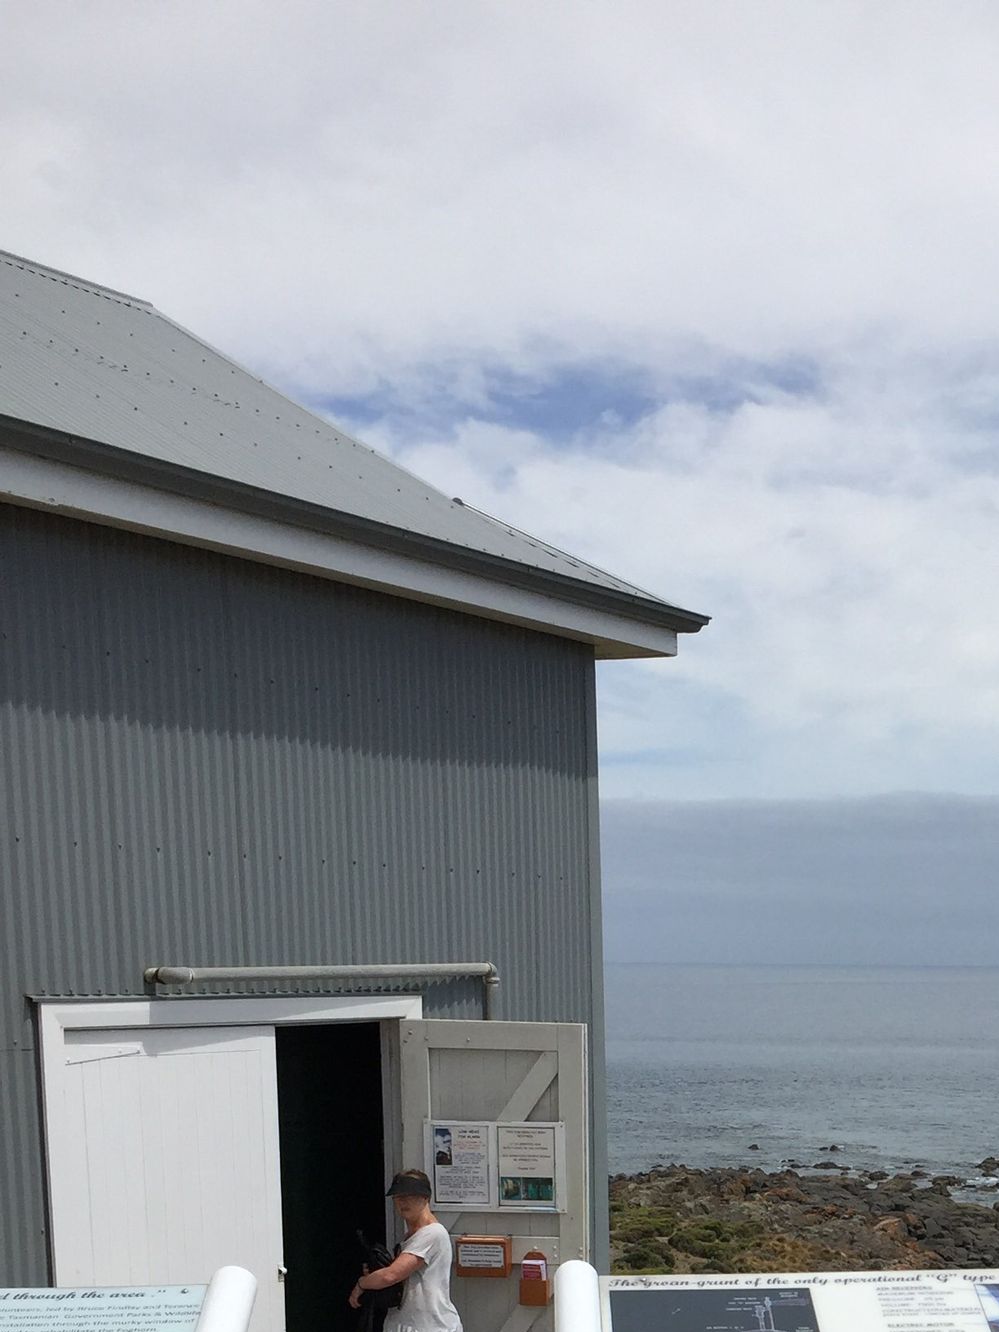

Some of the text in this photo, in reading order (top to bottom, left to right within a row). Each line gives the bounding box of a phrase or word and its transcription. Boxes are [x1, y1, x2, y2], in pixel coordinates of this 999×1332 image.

[745, 1277, 762, 1288] of
[767, 1277, 789, 1285] the
[794, 1276, 828, 1286] only
[834, 1273, 920, 1286] operational
[963, 1274, 994, 1283] type
[13, 1292, 76, 1301] through
[81, 1291, 104, 1299] the
